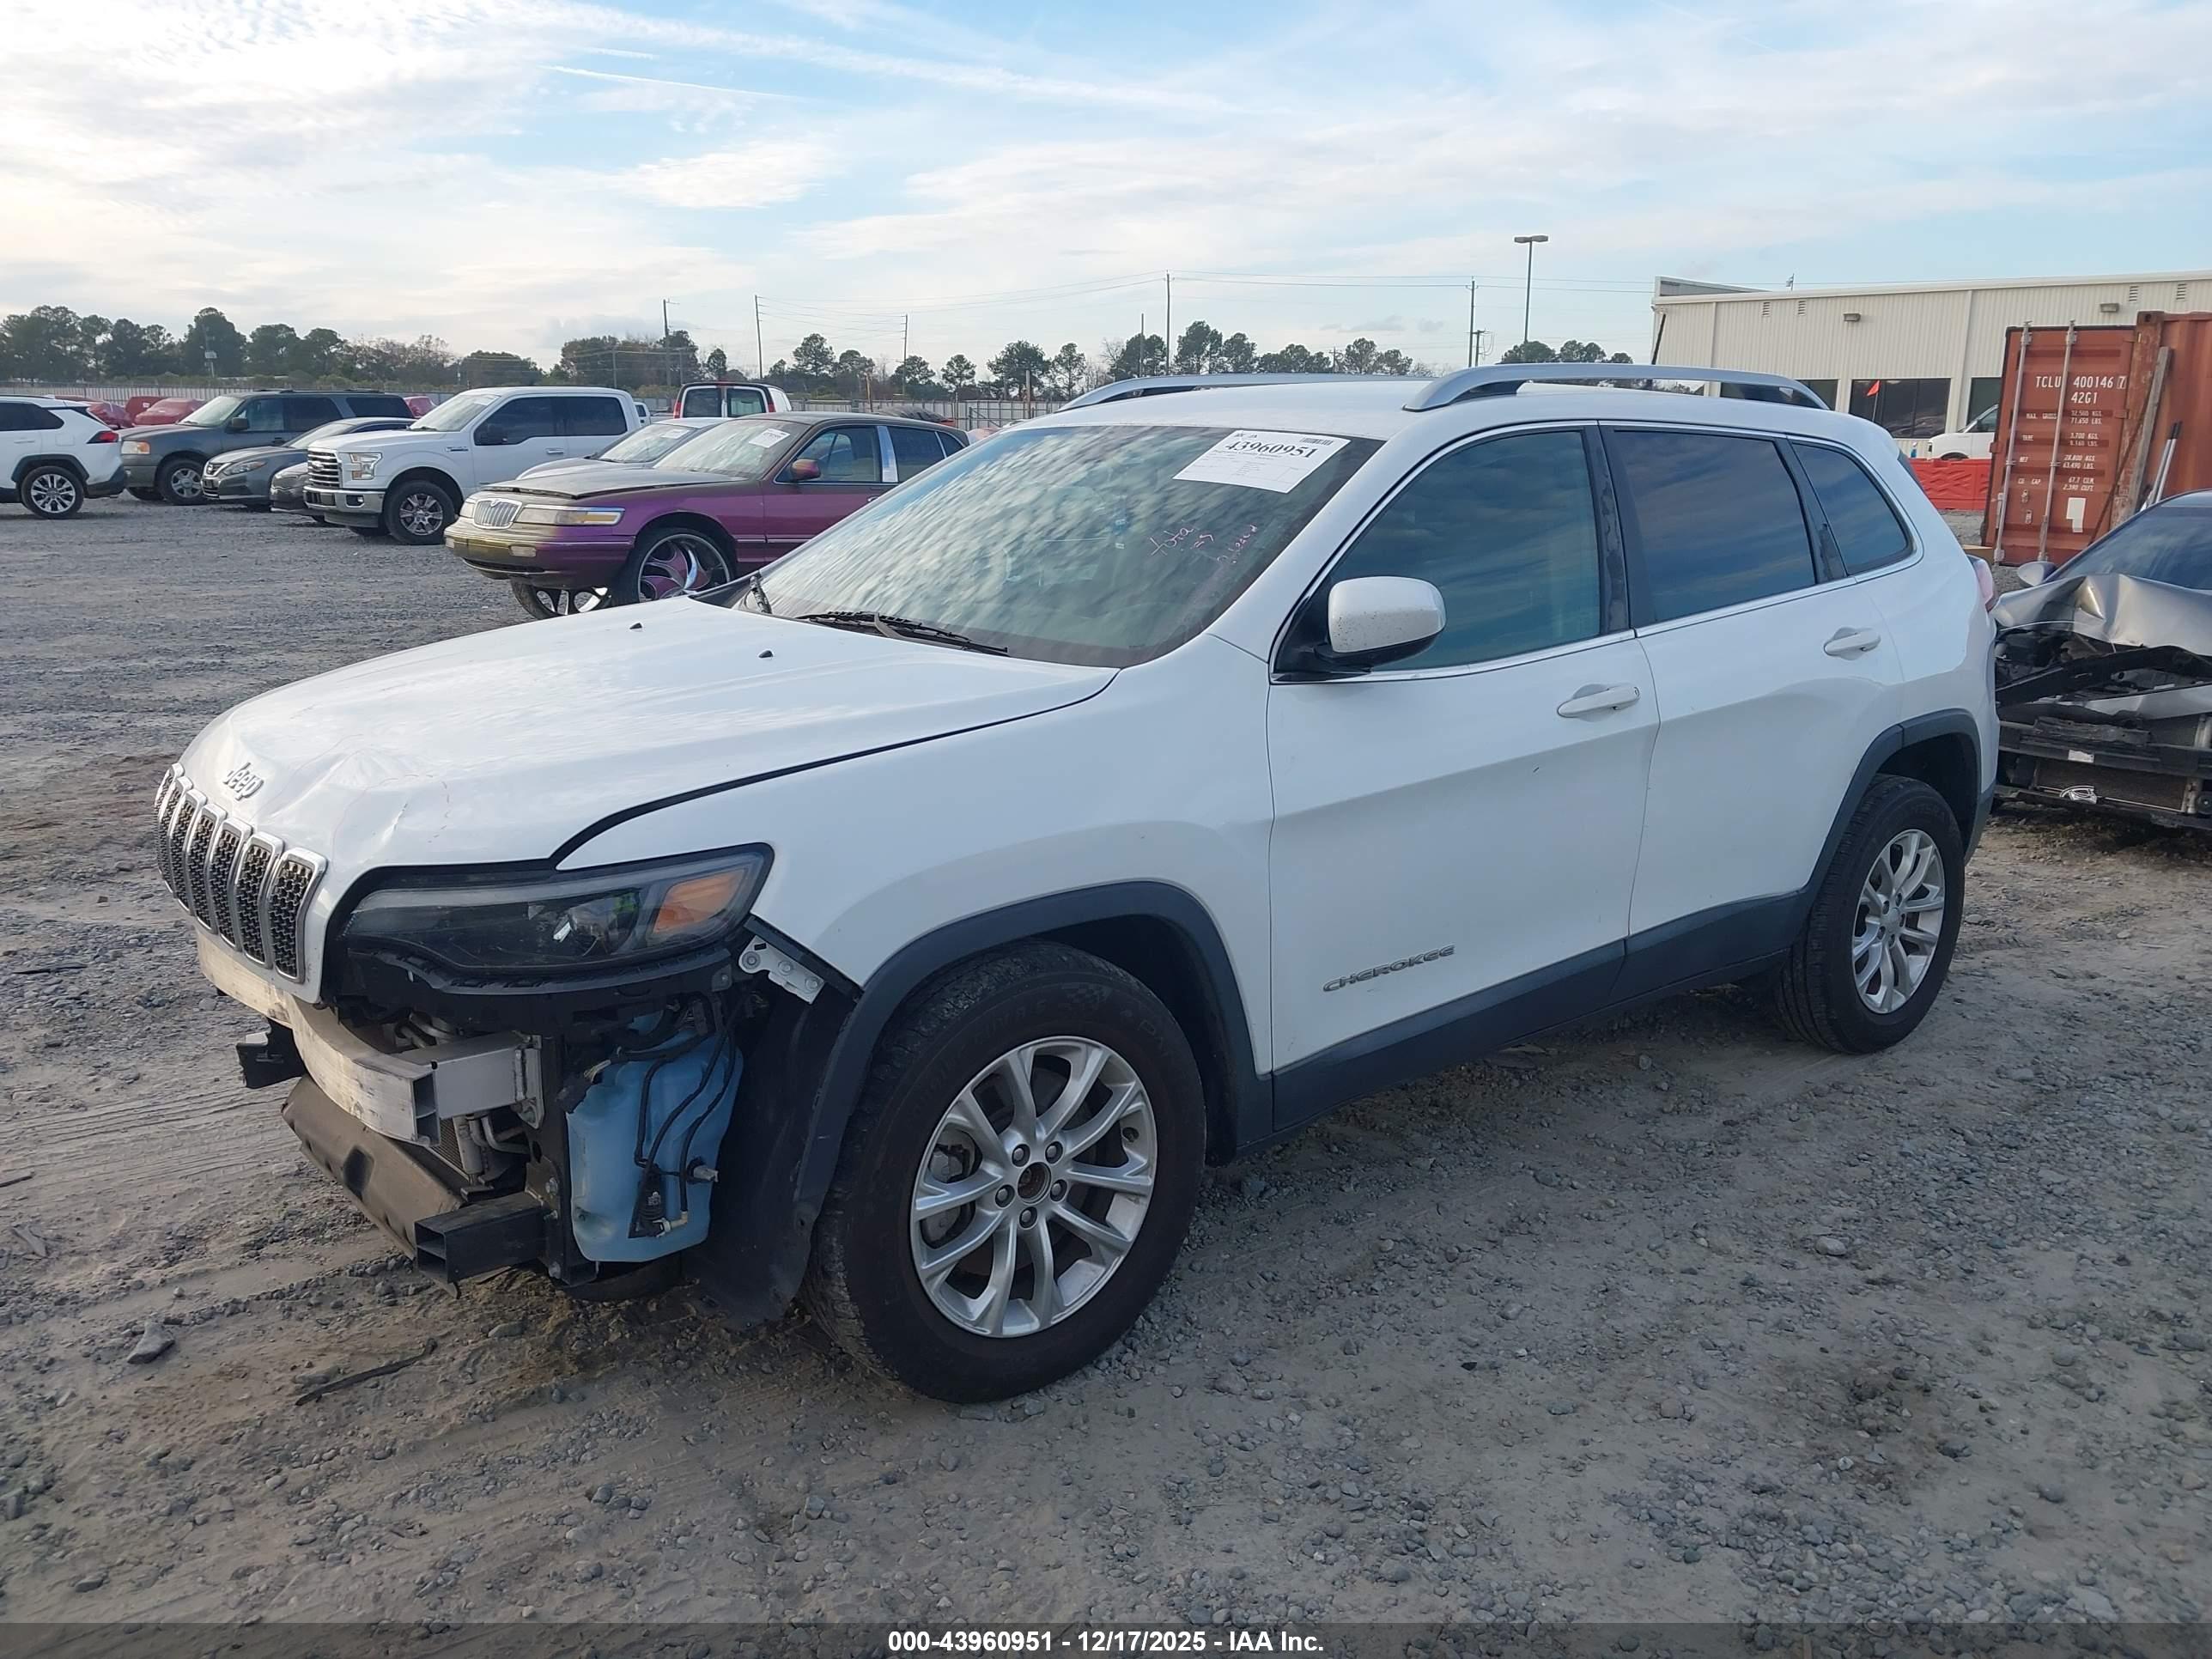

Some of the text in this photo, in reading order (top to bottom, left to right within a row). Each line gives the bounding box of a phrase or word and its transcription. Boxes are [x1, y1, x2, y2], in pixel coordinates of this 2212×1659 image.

[2036, 376, 2127, 389] TCLU 400146 7
[2071, 392, 2098, 404] 42G1
[1225, 441, 1318, 459] 43960951
[222, 763, 264, 801] Jeep
[1323, 945, 1456, 992] CHEROKEE
